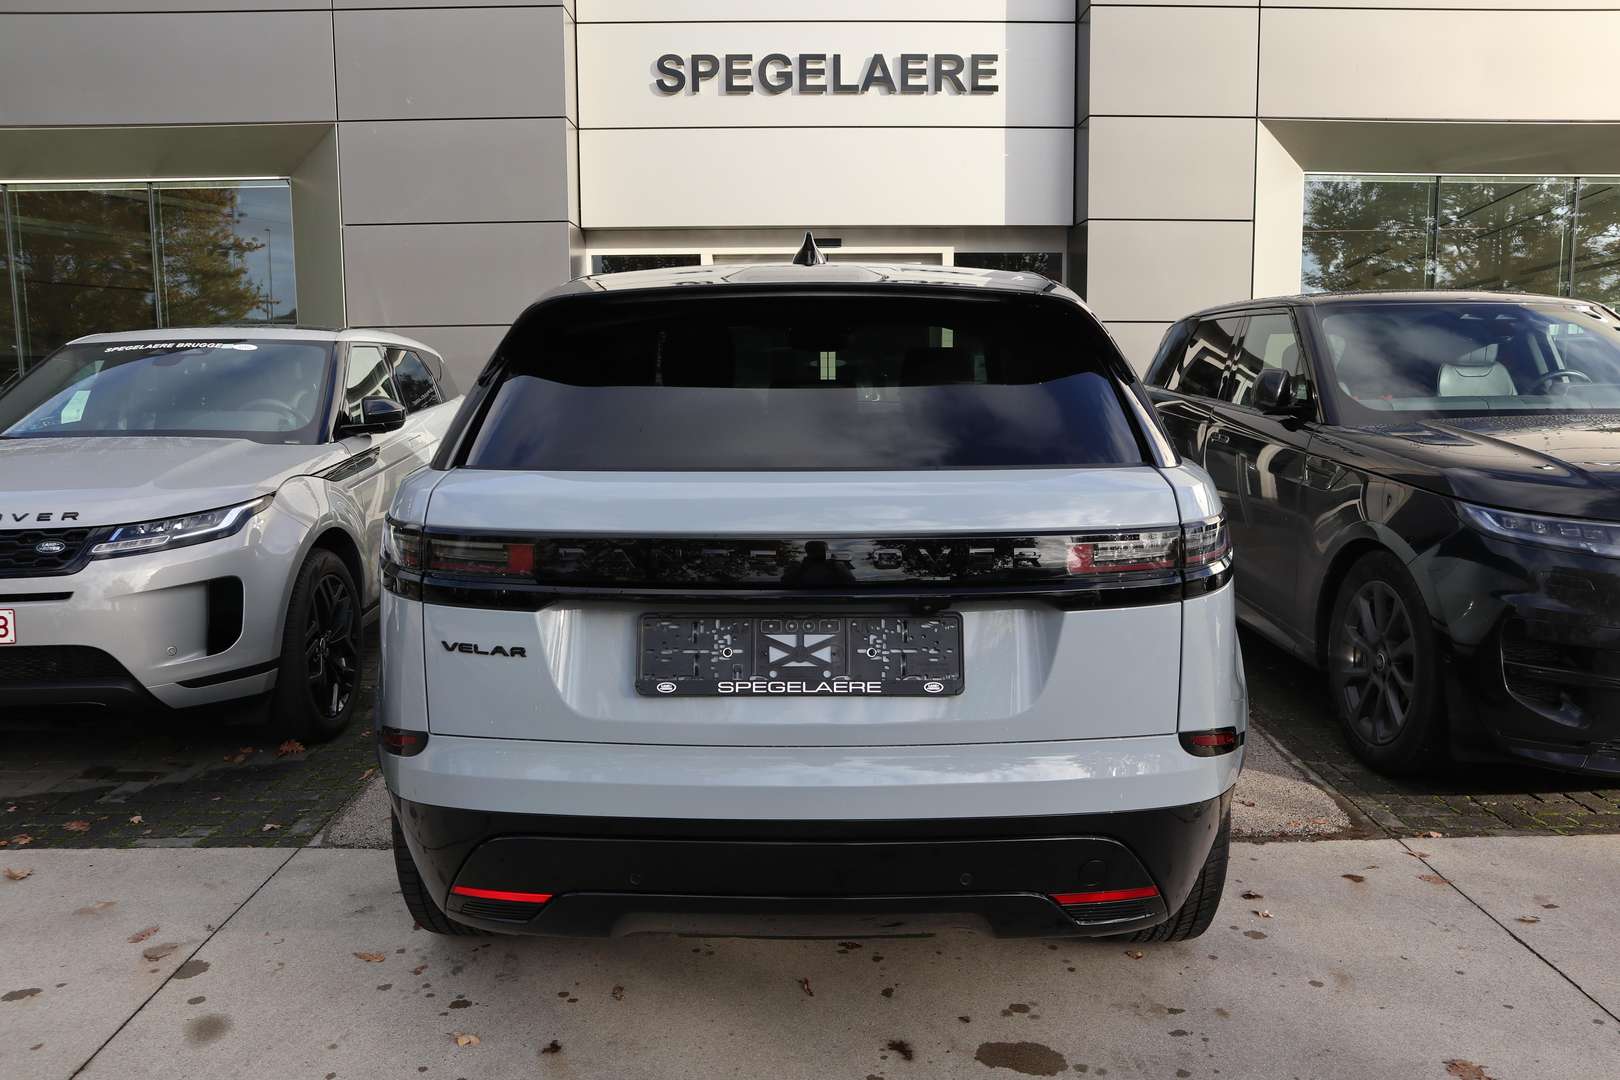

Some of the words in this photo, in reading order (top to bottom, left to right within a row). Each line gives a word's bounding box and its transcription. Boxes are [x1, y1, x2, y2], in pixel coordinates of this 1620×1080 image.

[655, 53, 999, 94] SPEGELAERE
[104, 343, 175, 353] SPEGELAERE
[0, 512, 79, 522] VER
[441, 640, 527, 658] VELAR
[718, 681, 882, 693] SPEGELAERE
